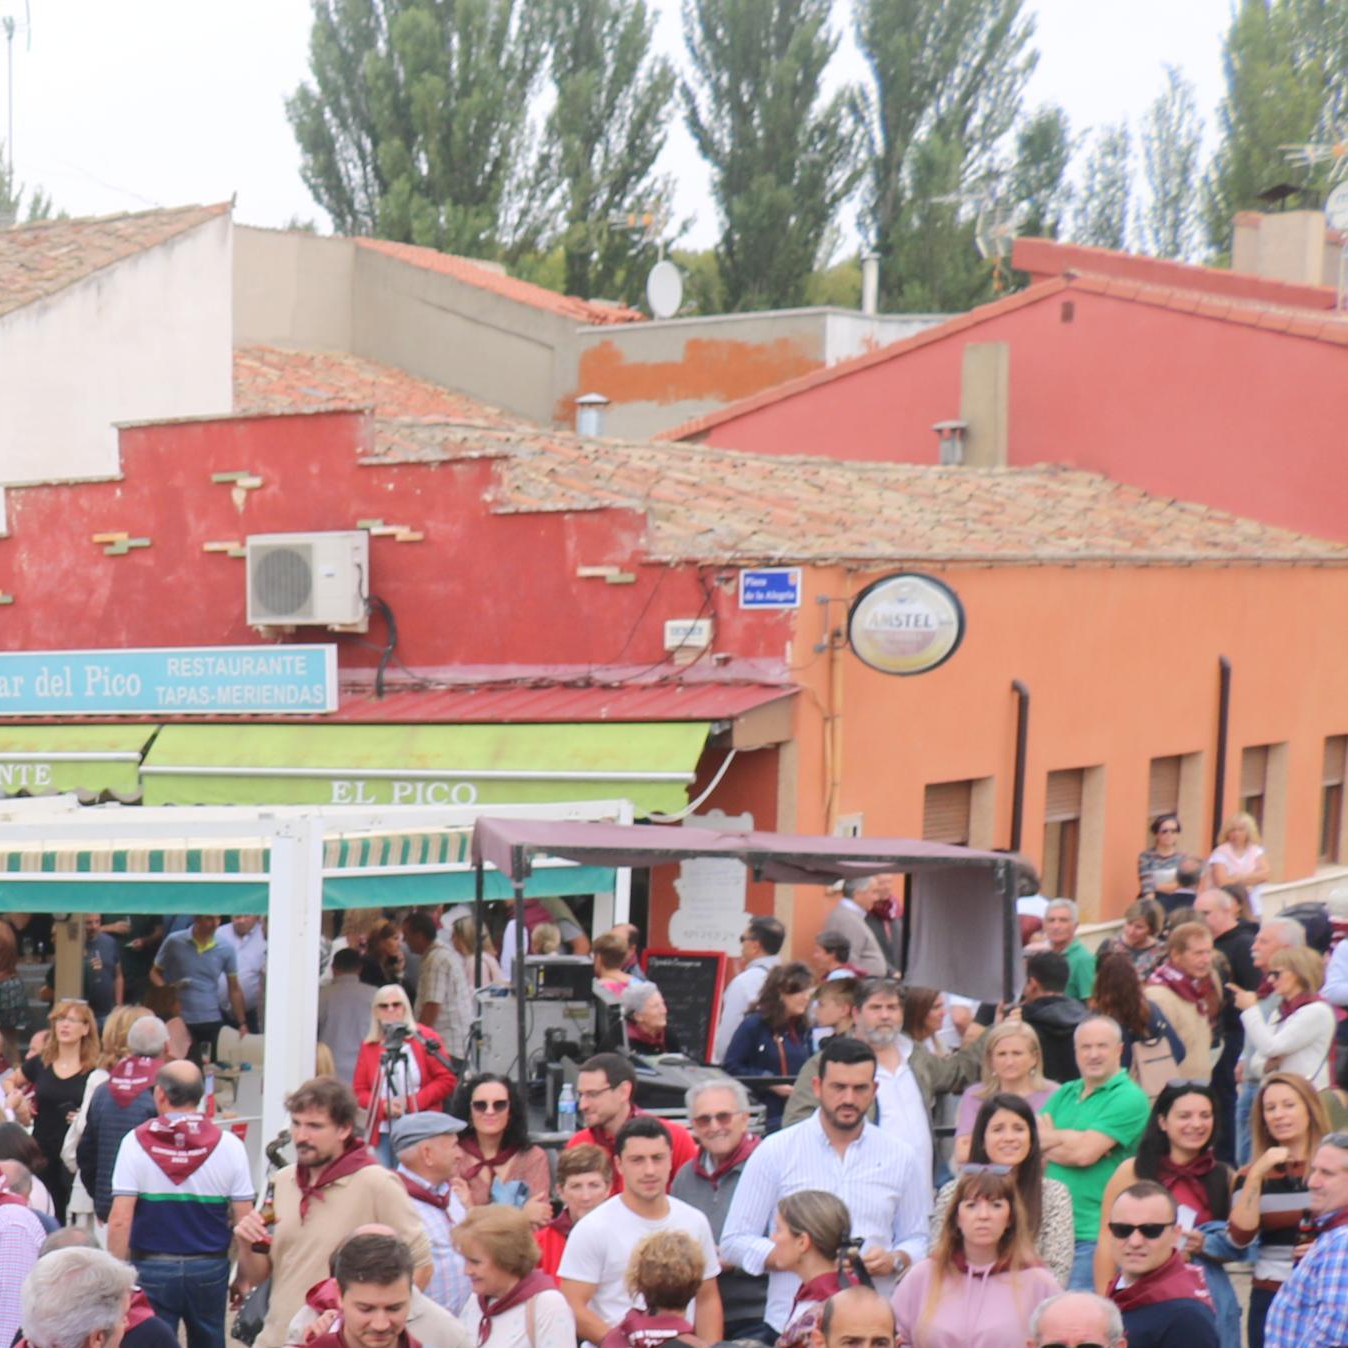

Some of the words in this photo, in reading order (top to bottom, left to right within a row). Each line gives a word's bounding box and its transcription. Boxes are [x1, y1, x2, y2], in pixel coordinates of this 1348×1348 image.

[868, 612, 933, 629] AMSTEL
[166, 656, 308, 677] RESTAURANTE
[35, 667, 74, 698] del
[84, 665, 142, 697] Pico
[155, 683, 325, 705] TAPAS-MERIENDAS
[330, 780, 377, 805] EL
[391, 780, 479, 806] PICO
